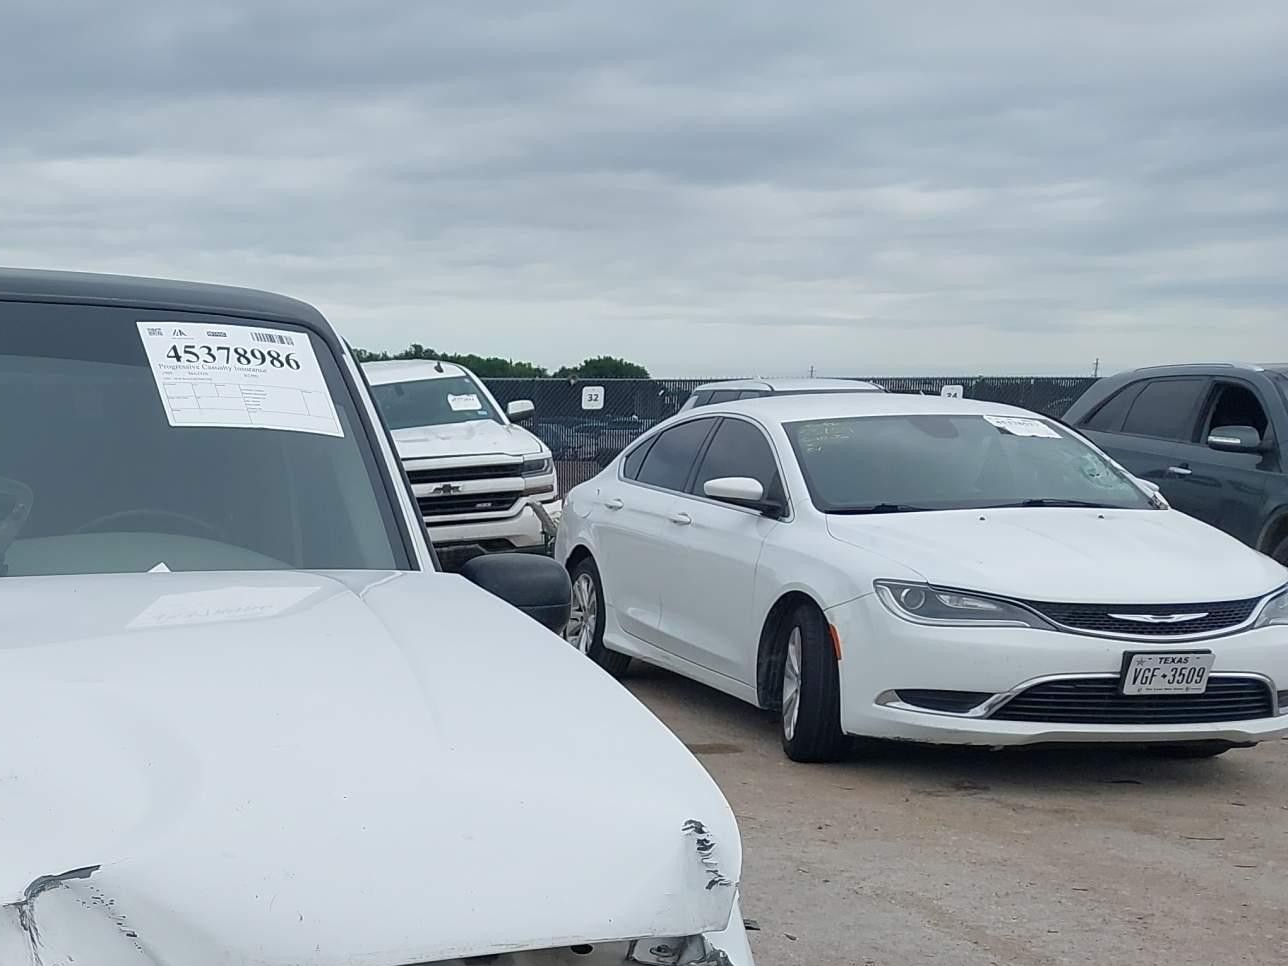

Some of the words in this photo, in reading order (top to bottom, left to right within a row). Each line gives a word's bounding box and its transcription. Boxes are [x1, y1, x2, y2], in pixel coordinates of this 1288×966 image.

[166, 344, 301, 370] 45378986
[587, 393, 599, 402] 32
[1158, 656, 1190, 665] TEXAS
